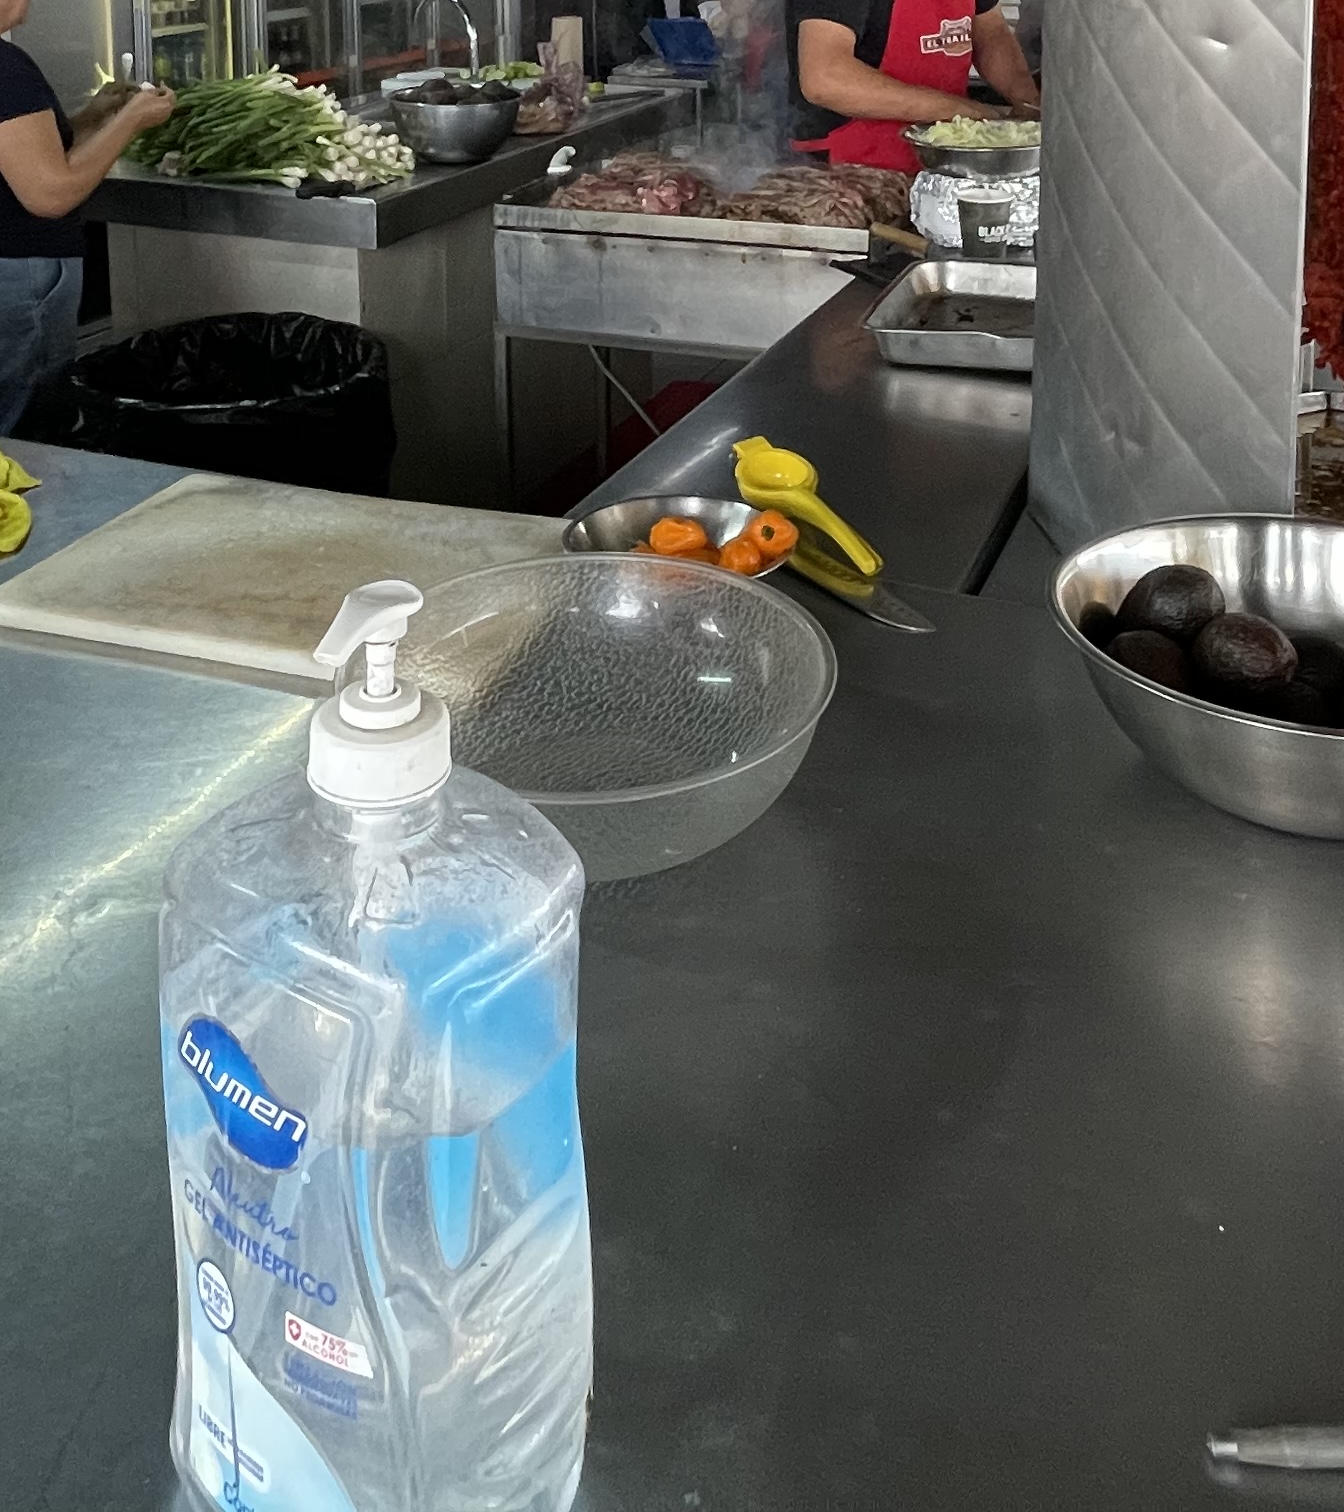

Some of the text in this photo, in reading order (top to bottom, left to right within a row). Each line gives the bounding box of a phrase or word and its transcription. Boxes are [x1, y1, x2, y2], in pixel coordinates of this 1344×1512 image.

[941, 33, 972, 45] TRAIL
[180, 1030, 308, 1143] blumen
[212, 1212, 338, 1307] ANTISÉPTICO
[301, 1338, 350, 1368] ALCOHOL
